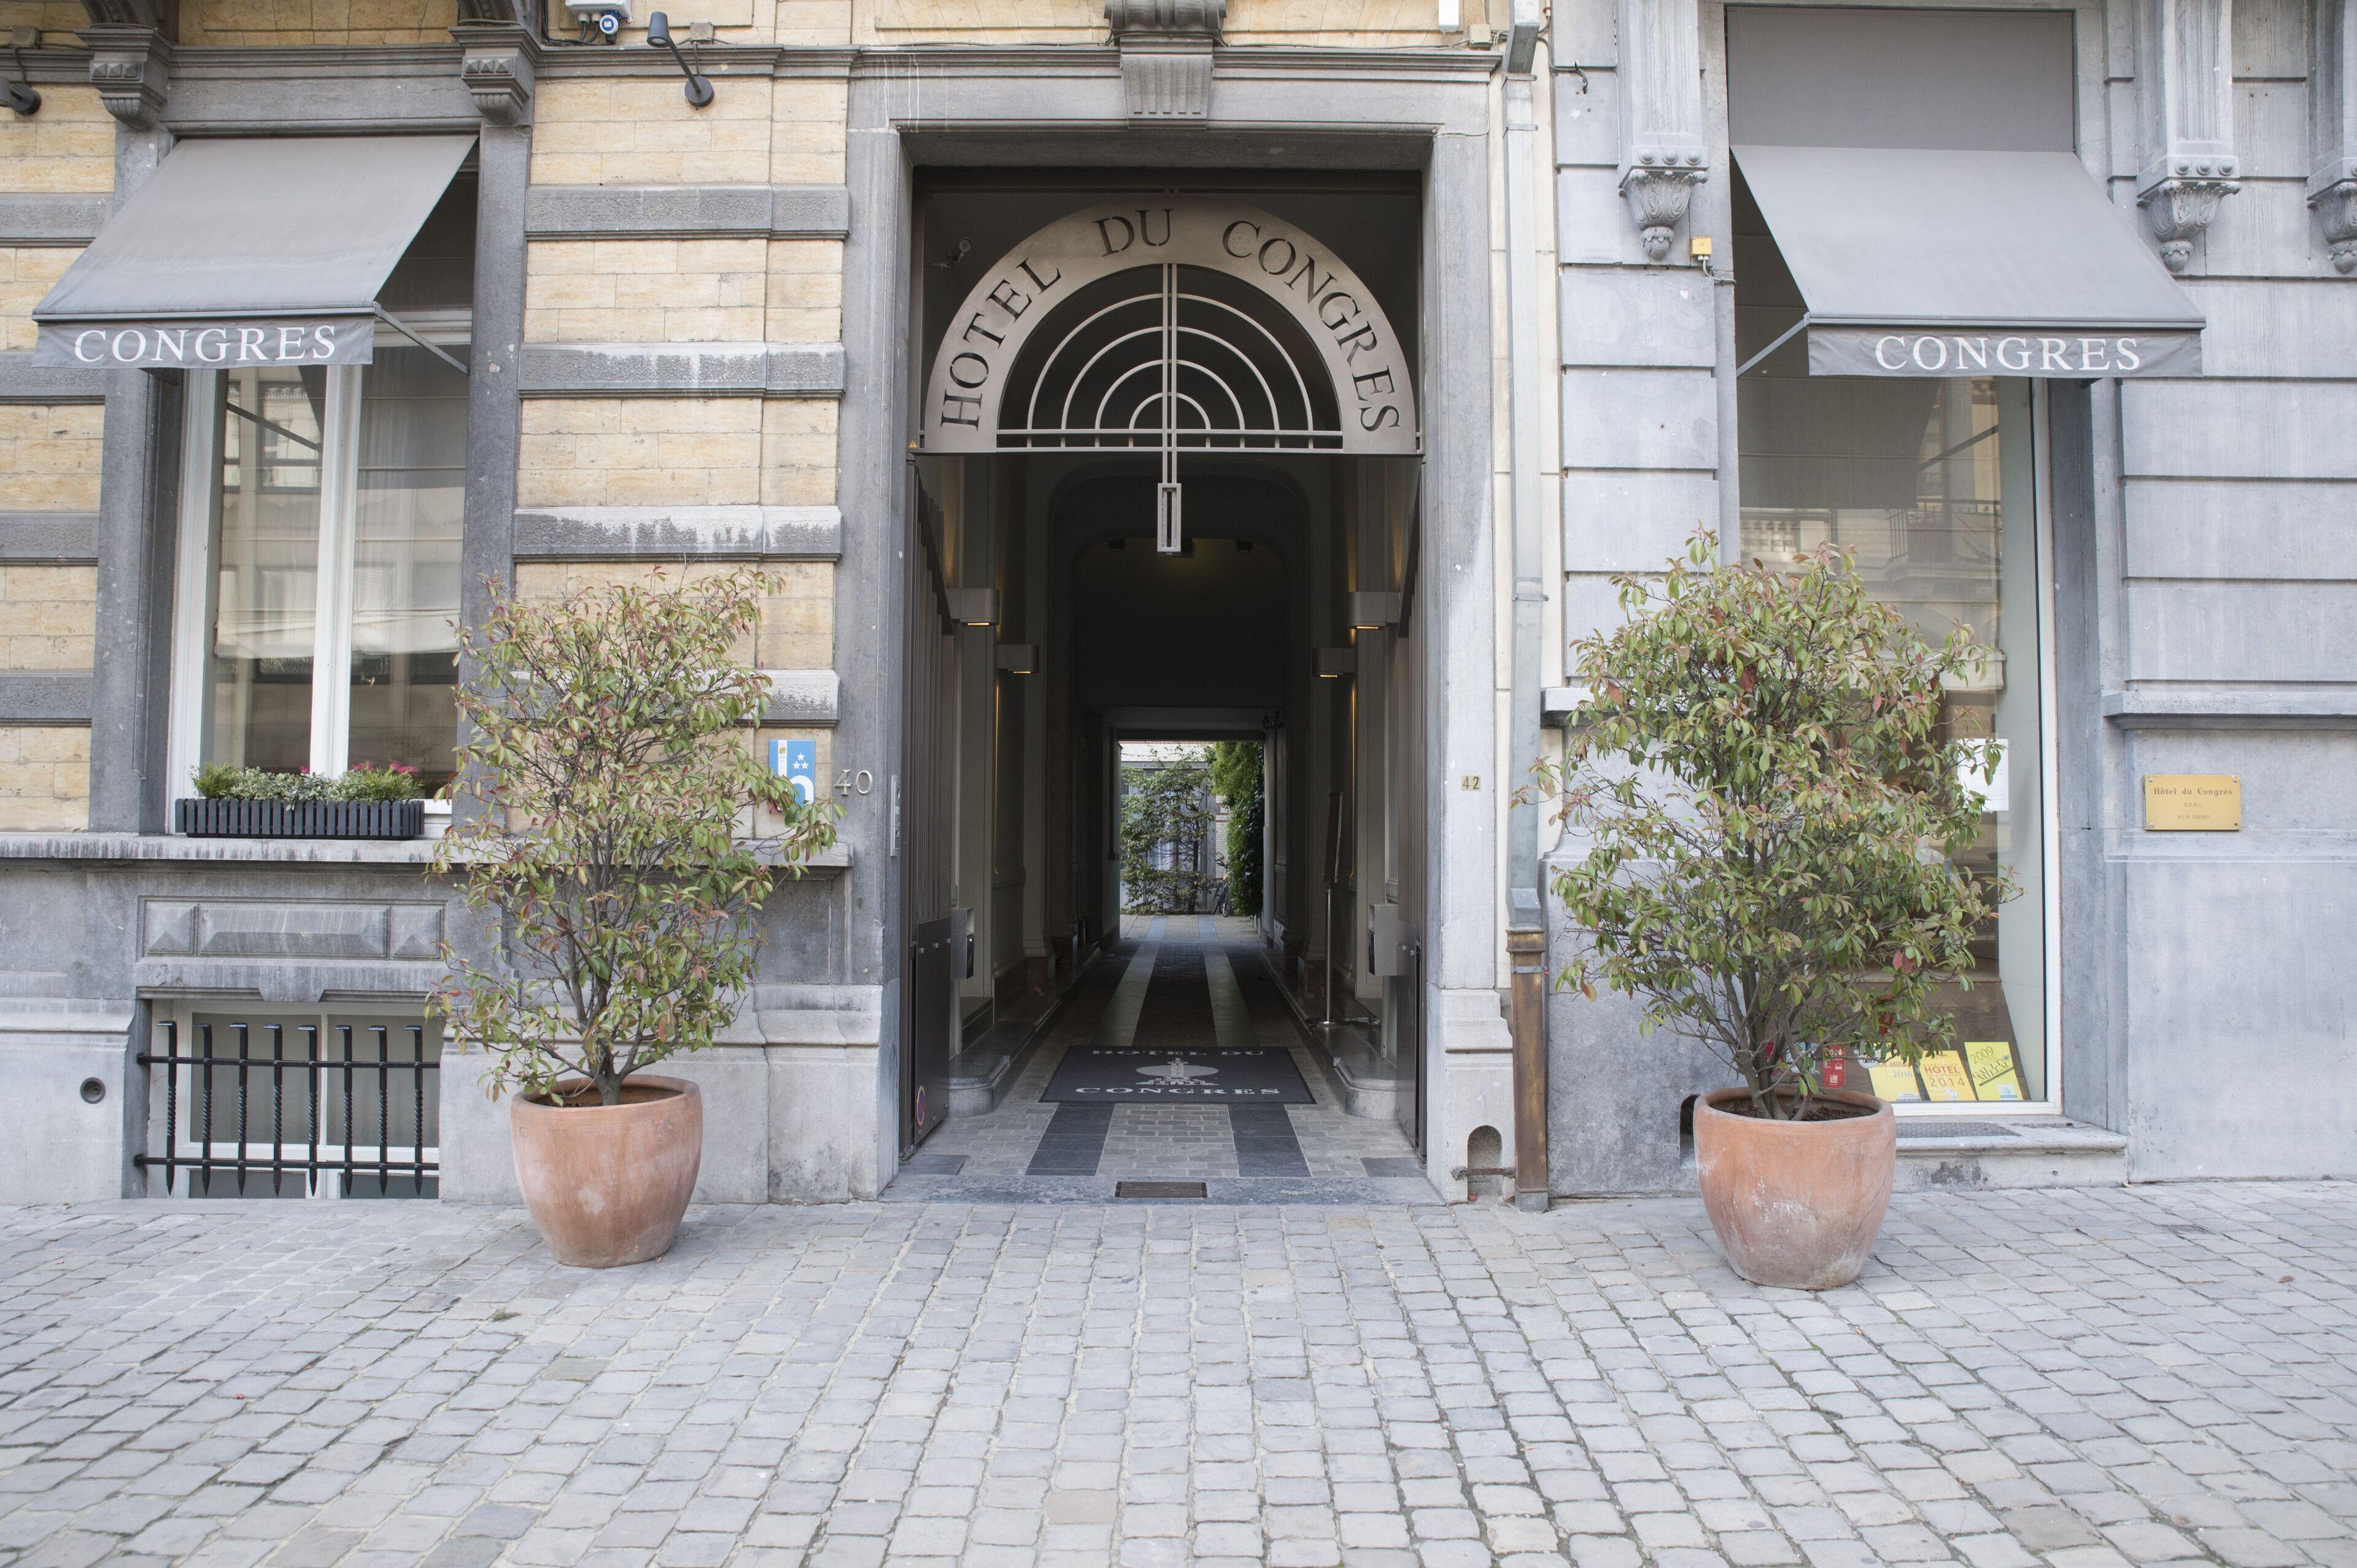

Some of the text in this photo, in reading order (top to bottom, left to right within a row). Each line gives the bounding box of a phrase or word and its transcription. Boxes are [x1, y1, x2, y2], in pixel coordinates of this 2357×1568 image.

[940, 207, 1401, 433] HOTEL DU CONGRES
[74, 325, 336, 363] CONGRES
[1874, 335, 2141, 371] CONGRES
[834, 769, 873, 796] 40
[1462, 776, 1480, 790] 42
[2197, 787, 2232, 797] Congrès
[1969, 1046, 1994, 1064] 2009
[1929, 1078, 1965, 1087] 2014
